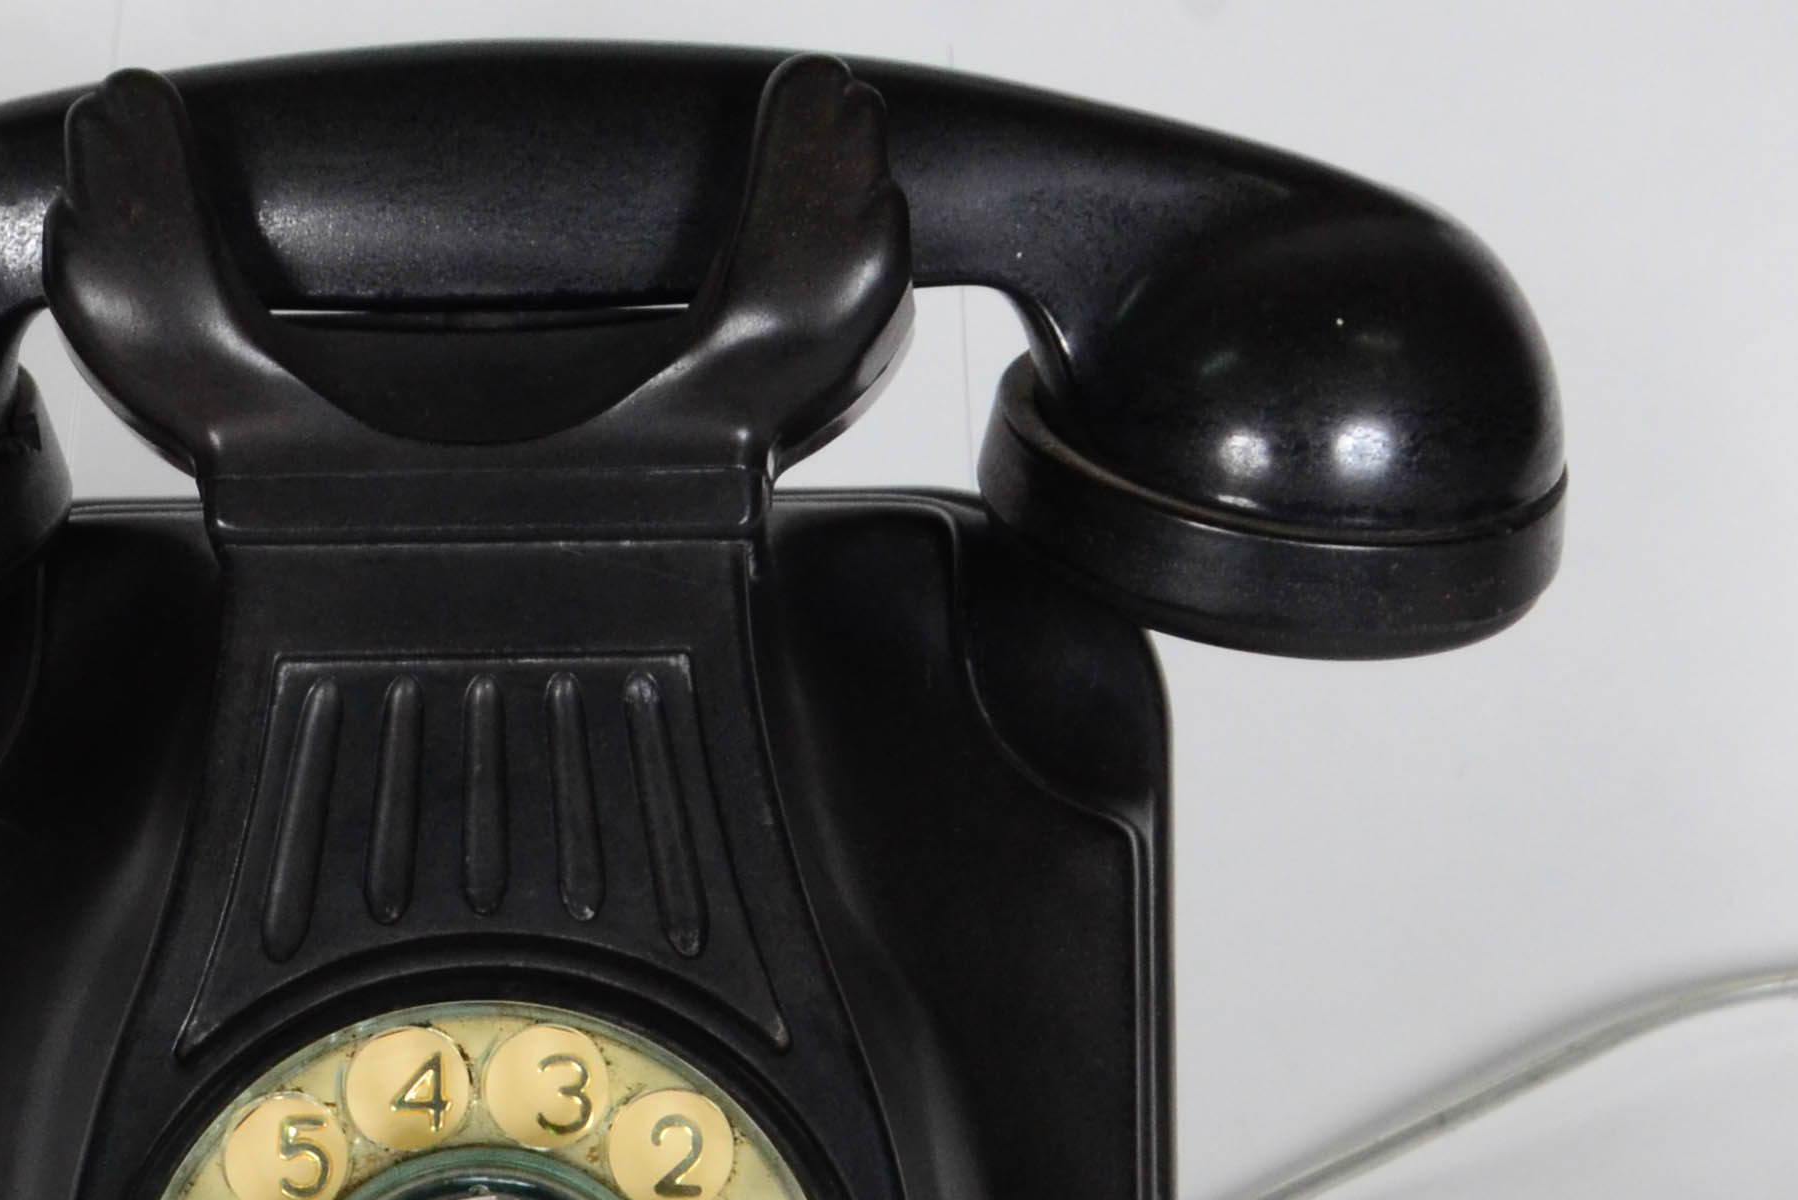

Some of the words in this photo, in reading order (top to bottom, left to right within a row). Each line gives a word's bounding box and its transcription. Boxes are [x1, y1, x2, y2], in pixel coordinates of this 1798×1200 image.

[391, 1052, 451, 1132] 4
[537, 1054, 592, 1135] 3
[278, 1113, 332, 1199] 5
[651, 1114, 703, 1197] 2
